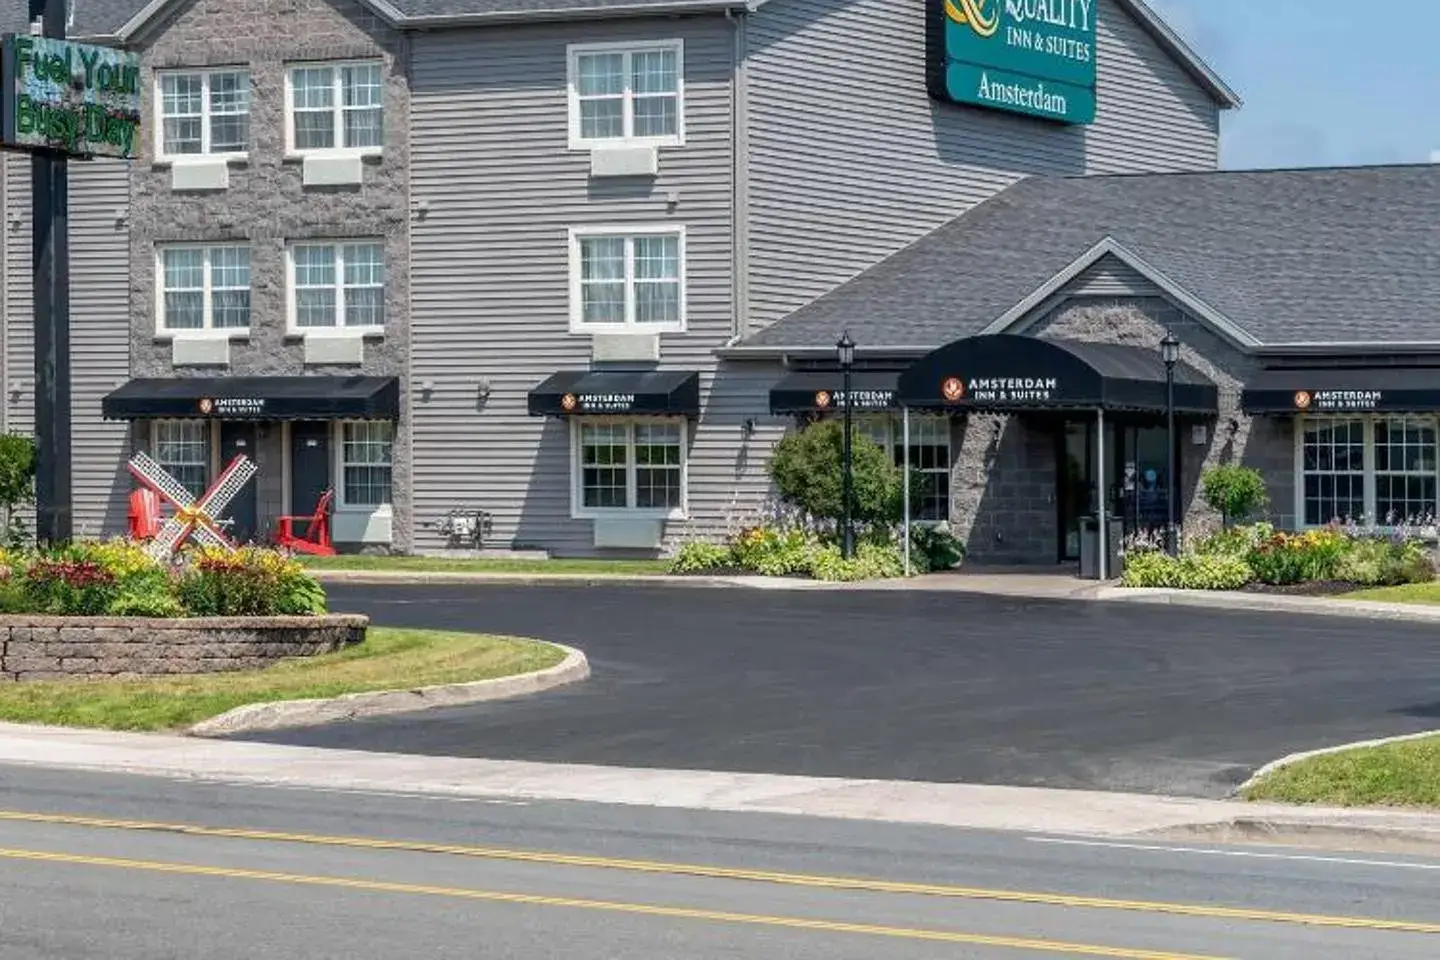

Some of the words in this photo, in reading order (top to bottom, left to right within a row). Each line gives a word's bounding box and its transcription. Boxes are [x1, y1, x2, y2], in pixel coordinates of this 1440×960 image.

[1007, 26, 1032, 50] INN
[1034, 33, 1044, 50] &
[1046, 35, 1090, 62] SUITES
[16, 38, 72, 83] Fuel
[77, 47, 140, 93] Your
[977, 72, 1067, 114] Amsterdam
[17, 93, 80, 153] Busy
[85, 103, 137, 158] Day
[969, 378, 1057, 389] AMSTERDAM
[975, 391, 996, 400] INN
[1314, 391, 1382, 400] AMSTERDAM
